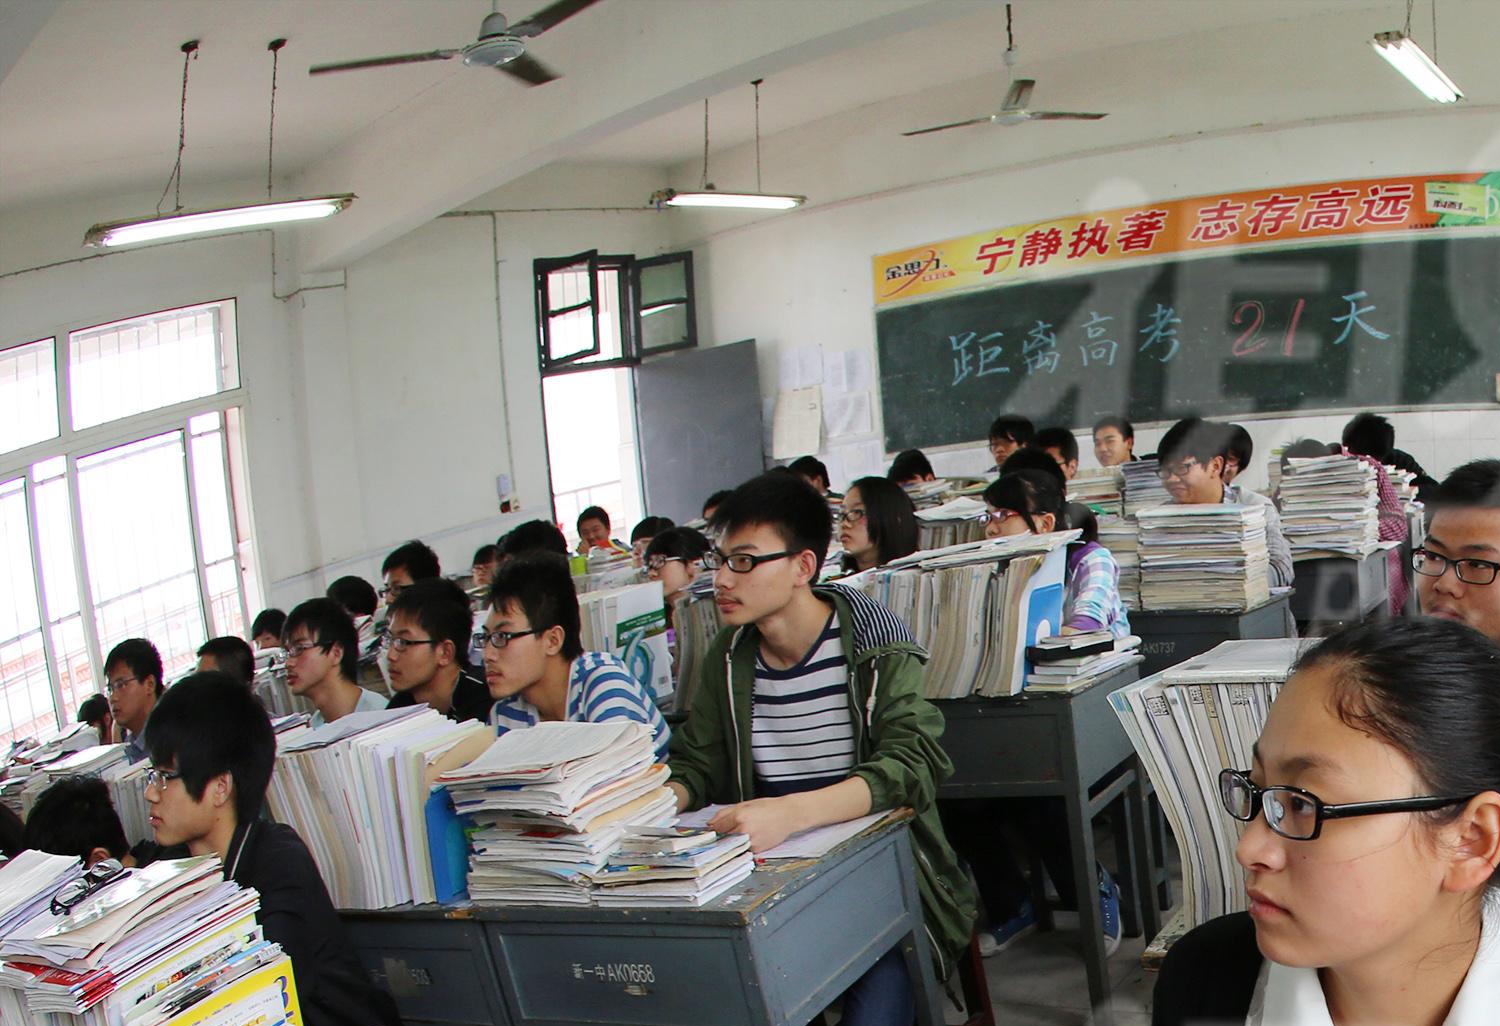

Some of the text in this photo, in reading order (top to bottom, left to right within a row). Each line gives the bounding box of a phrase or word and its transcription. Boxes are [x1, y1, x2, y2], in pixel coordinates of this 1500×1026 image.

[976, 183, 1414, 276] 宁静执著 志存高远
[1229, 298, 1305, 357] 21
[1331, 290, 1391, 346] 天
